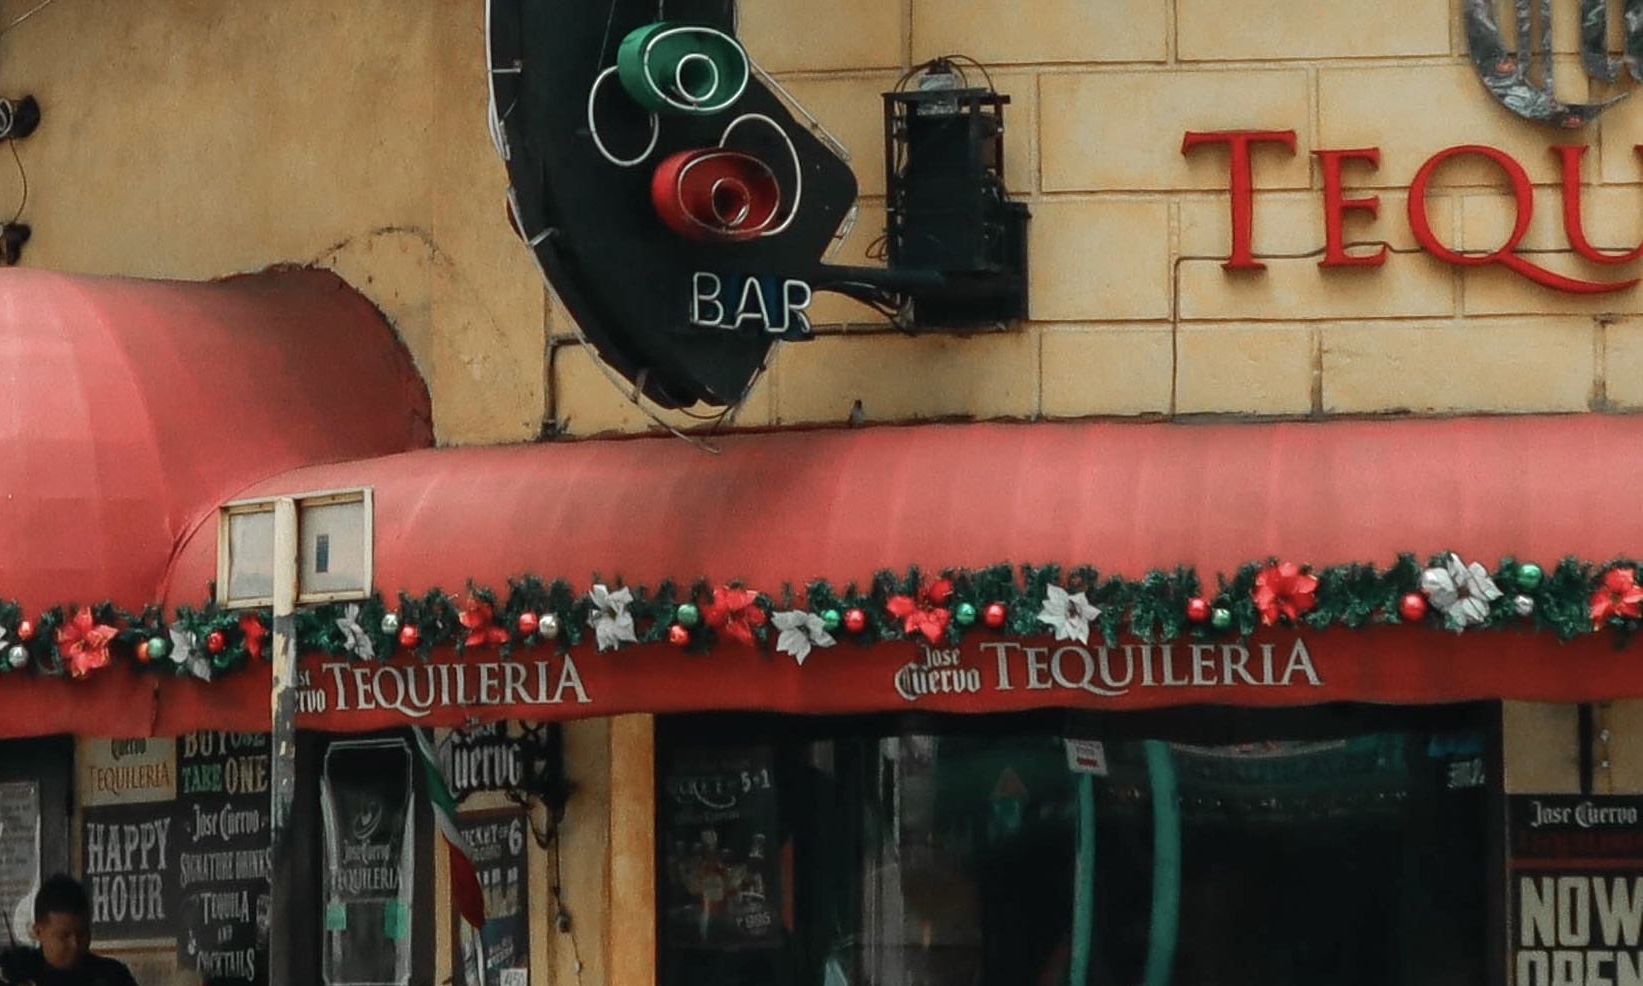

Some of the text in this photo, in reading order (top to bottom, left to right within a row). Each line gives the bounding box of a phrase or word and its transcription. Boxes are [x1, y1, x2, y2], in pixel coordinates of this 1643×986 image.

[1180, 129, 1643, 294] TEQU
[690, 271, 812, 335] BAR
[920, 642, 962, 669] Jose
[980, 637, 1325, 696] TEQUILERIA
[321, 653, 592, 718] TEQUILERIA
[894, 661, 982, 702] Cuervo
[183, 731, 228, 758] BUY
[87, 762, 171, 797] TEQUILERIA
[181, 754, 269, 795] TAKE ONE
[1530, 800, 1638, 829] Jose Cuervo
[86, 816, 171, 874] HAPPY
[508, 818, 523, 857] 6
[235, 847, 273, 884] DRINKS
[91, 873, 166, 924] HOUR
[199, 890, 250, 926] TEQUILA
[1520, 875, 1643, 947] NOW
